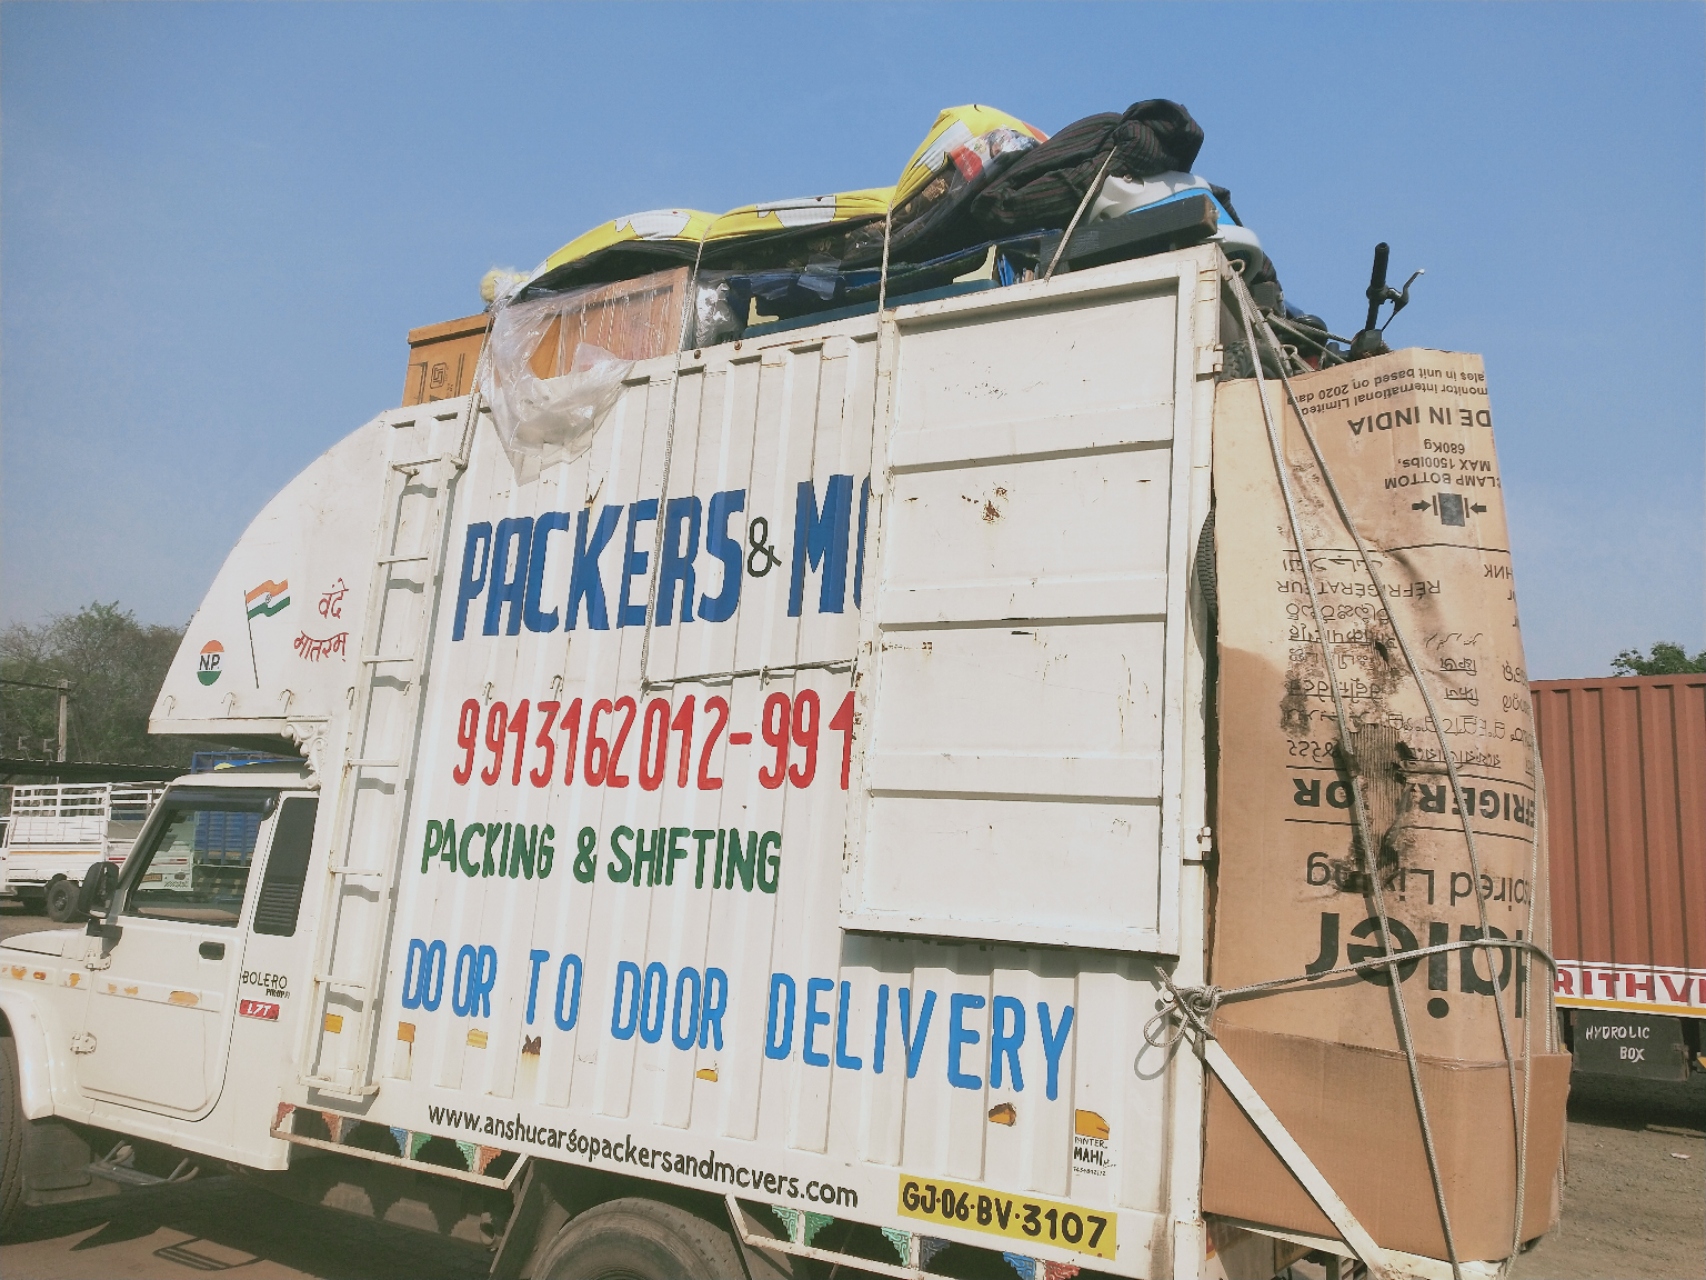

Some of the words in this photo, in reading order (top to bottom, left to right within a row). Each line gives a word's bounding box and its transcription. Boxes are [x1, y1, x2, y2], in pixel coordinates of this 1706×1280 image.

[1375, 368, 1416, 386] based
[1418, 367, 1440, 382] unit
[1445, 367, 1457, 381] in
[1319, 382, 1350, 399] 2020
[1354, 381, 1439, 407] international
[1347, 405, 1421, 436] INDIA
[1430, 406, 1453, 425] IN
[1424, 438, 1465, 455] 680Kg
[1462, 458, 1491, 472] MAX
[1384, 473, 1451, 490] BOTTOM
[452, 489, 746, 641] PACKERS
[747, 516, 782, 578] &
[420, 818, 555, 880] PACKING
[572, 826, 597, 884] &
[607, 825, 782, 894] SHIFTING
[242, 970, 288, 989] BOLERO
[525, 948, 583, 1032] TO
[610, 960, 728, 1052] DOOR
[764, 972, 1075, 1101] DELIVERY
[1585, 1025, 1651, 1040] HYDROLIC
[1620, 1046, 1645, 1063] BOX
